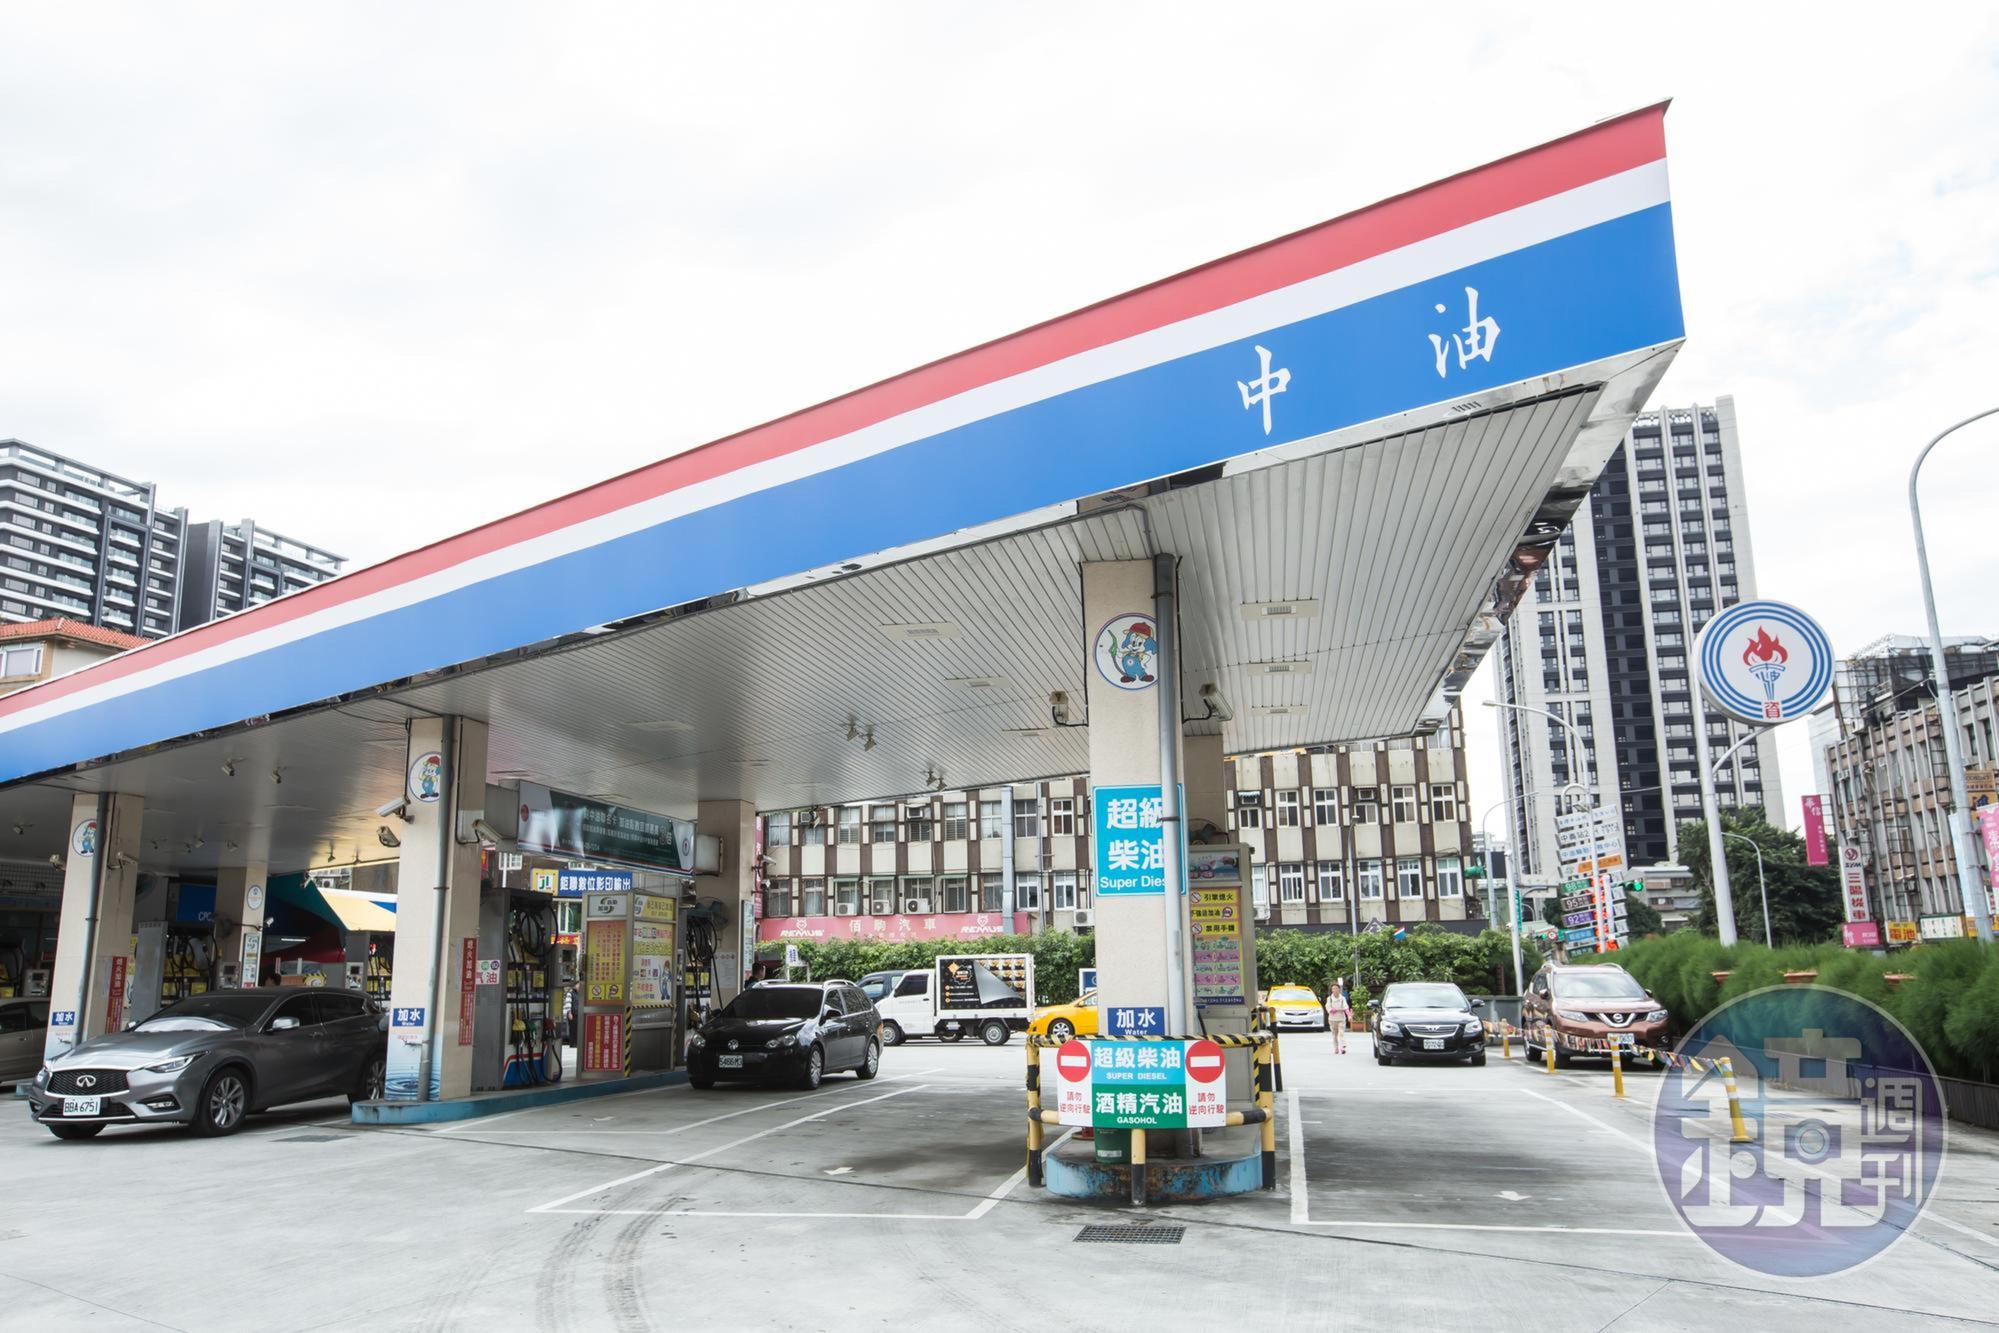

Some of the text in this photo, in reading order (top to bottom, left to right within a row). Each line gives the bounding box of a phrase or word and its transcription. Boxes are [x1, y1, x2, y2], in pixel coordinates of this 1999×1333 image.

[1107, 838, 1165, 871] 柴油
[1100, 876, 1138, 891] Super
[1565, 882, 1577, 892] 98
[1566, 899, 1579, 909] 95
[1568, 915, 1580, 925] 92
[780, 928, 824, 938] REMUS
[56, 1011, 73, 1022] 加水
[397, 1008, 421, 1022] 加水
[1116, 1008, 1157, 1029] 加水
[1124, 1028, 1147, 1036] Water
[1094, 1046, 1181, 1070] 超級柴油
[1106, 1072, 1167, 1081] SUPER DIESEL
[1066, 1091, 1083, 1102] 請勿
[1197, 1091, 1216, 1103] 請勿
[1058, 1102, 1091, 1116] 逆向行駛
[1096, 1091, 1183, 1116] 酒精汽油
[1189, 1103, 1225, 1116] 逆向行駛
[1117, 1116, 1157, 1125] GASOHOL
